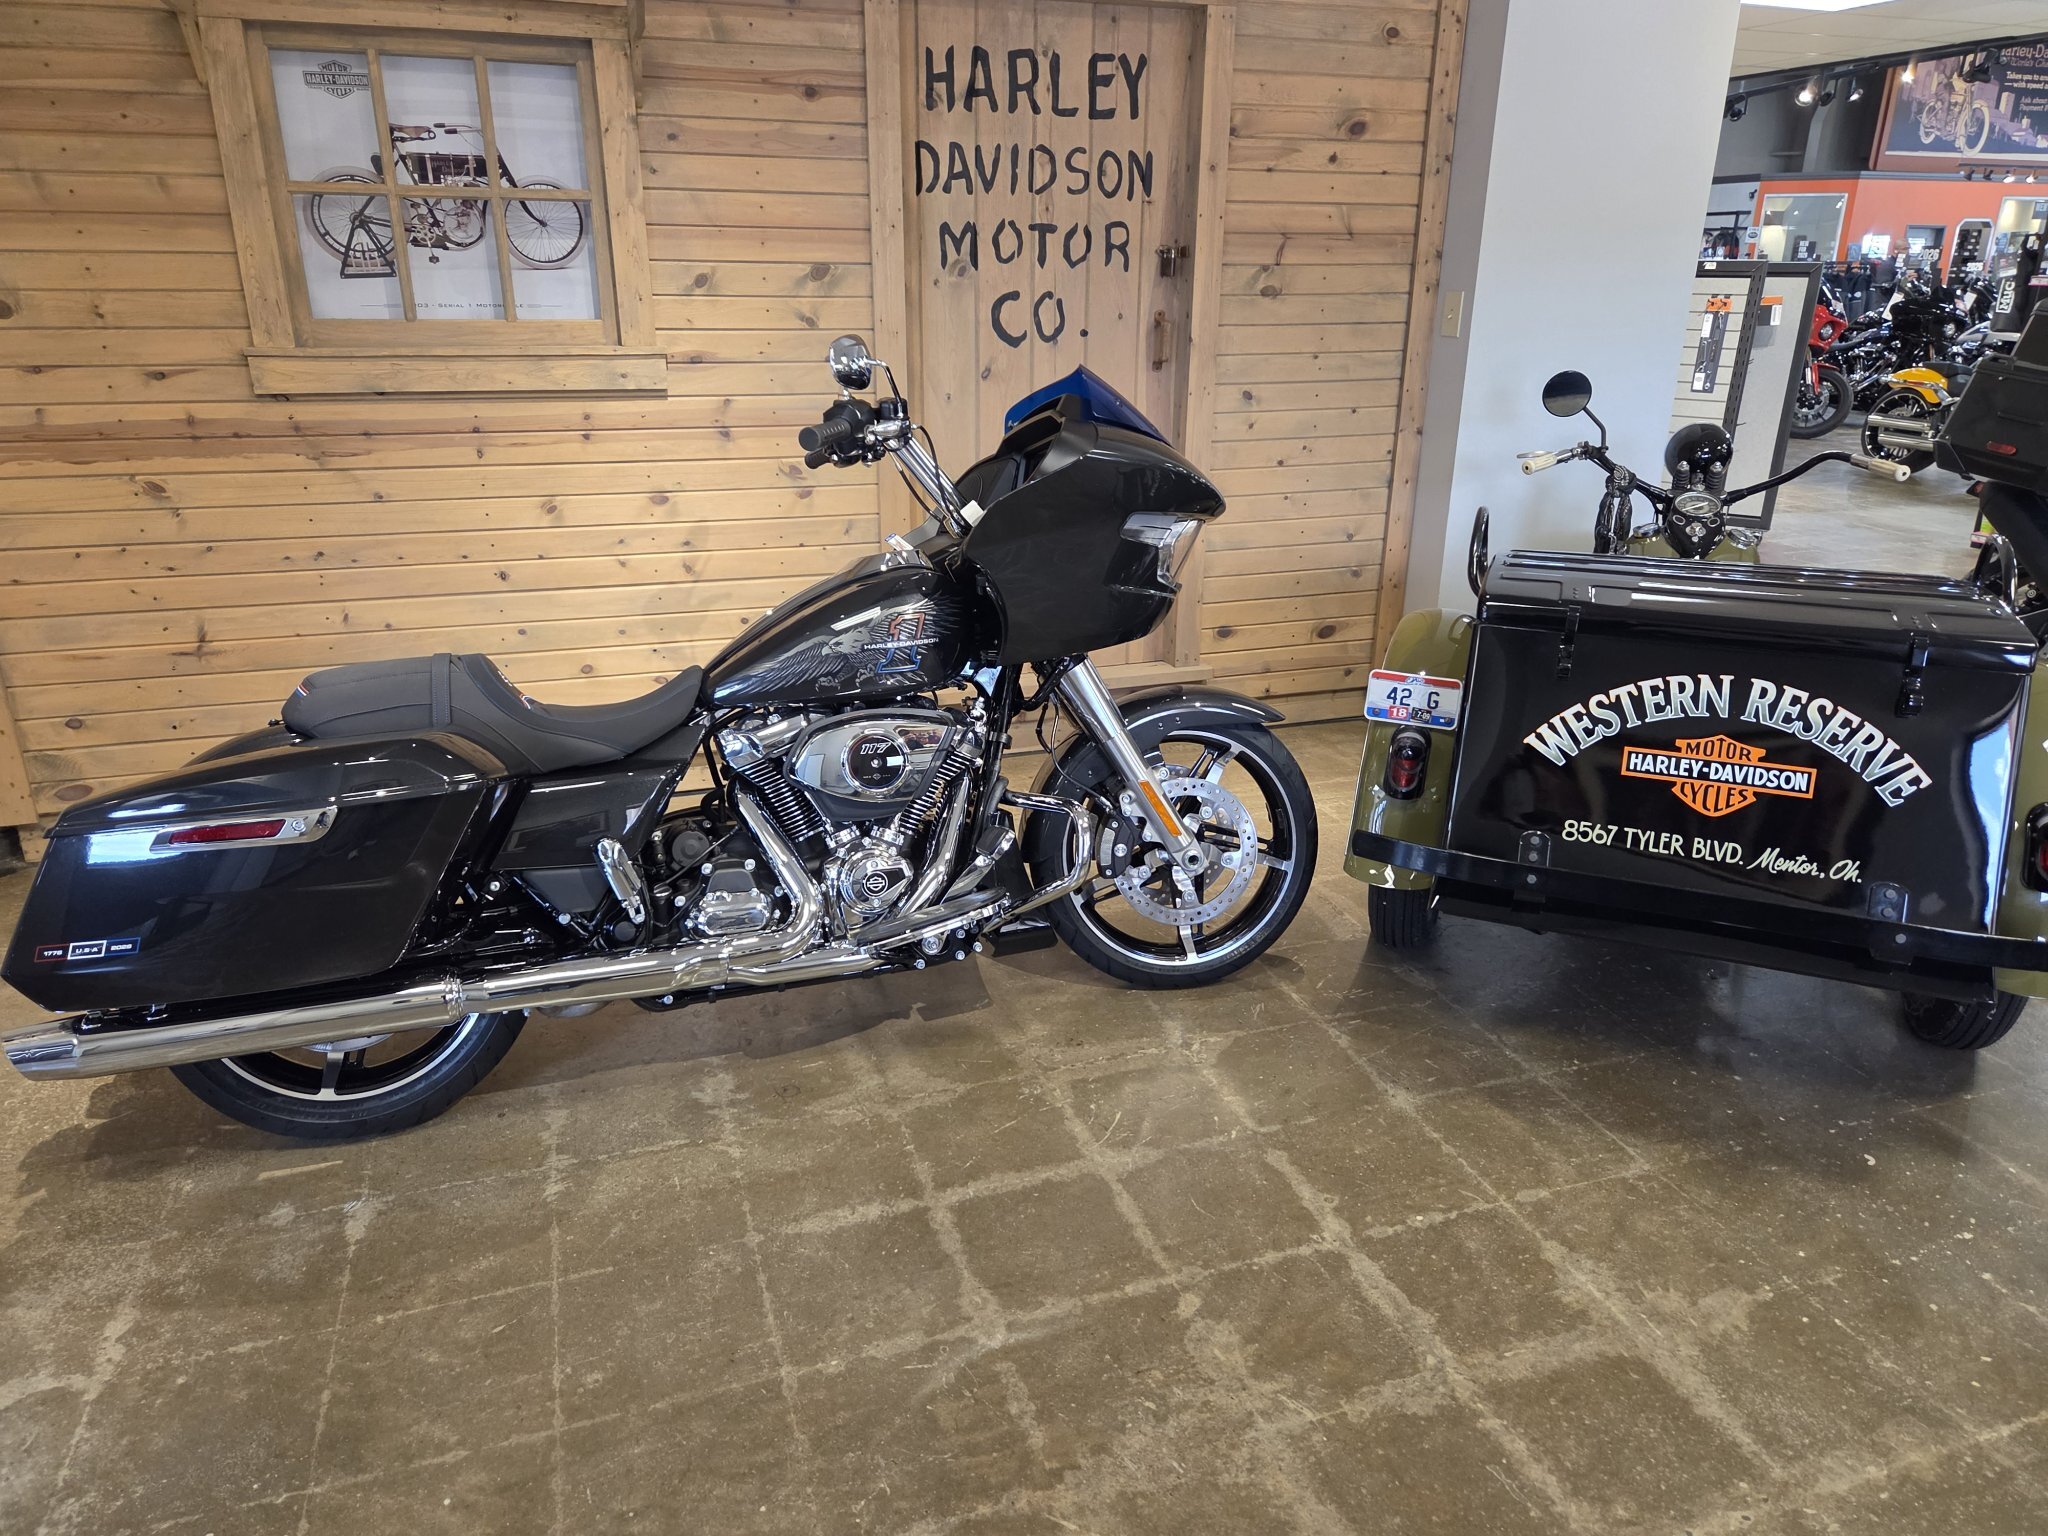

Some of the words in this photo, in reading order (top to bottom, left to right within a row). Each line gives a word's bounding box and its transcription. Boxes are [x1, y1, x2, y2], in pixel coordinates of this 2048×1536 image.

[321, 62, 348, 71] MOTOR
[305, 73, 369, 86] HARLEY-DAVIDSON
[326, 87, 352, 96] CYCLES
[924, 45, 1148, 120] HARLEY
[915, 139, 1153, 201] DAVIDSON
[939, 218, 1131, 272] MOTOR
[1918, 248, 1940, 261] 2026
[991, 290, 1089, 348] CO.
[864, 638, 939, 649] HARLEY-DAVIDSON
[1387, 687, 1412, 706] 42
[1427, 691, 1440, 710] G
[1391, 707, 1408, 719] 18
[860, 742, 892, 755] 117
[1522, 674, 1735, 767] WESTERN
[1740, 677, 1933, 808] RESERVE
[1684, 738, 1752, 762] MOTOR
[1627, 752, 1809, 793] HARLEY-DAVIDSON
[1679, 781, 1750, 814] CYCLES
[1562, 819, 1618, 846] 8567
[1623, 827, 1685, 857] TYLER
[1691, 838, 1744, 866] BLVD.
[1747, 847, 1826, 881] Mentor,
[1829, 858, 1863, 885] Oh.
